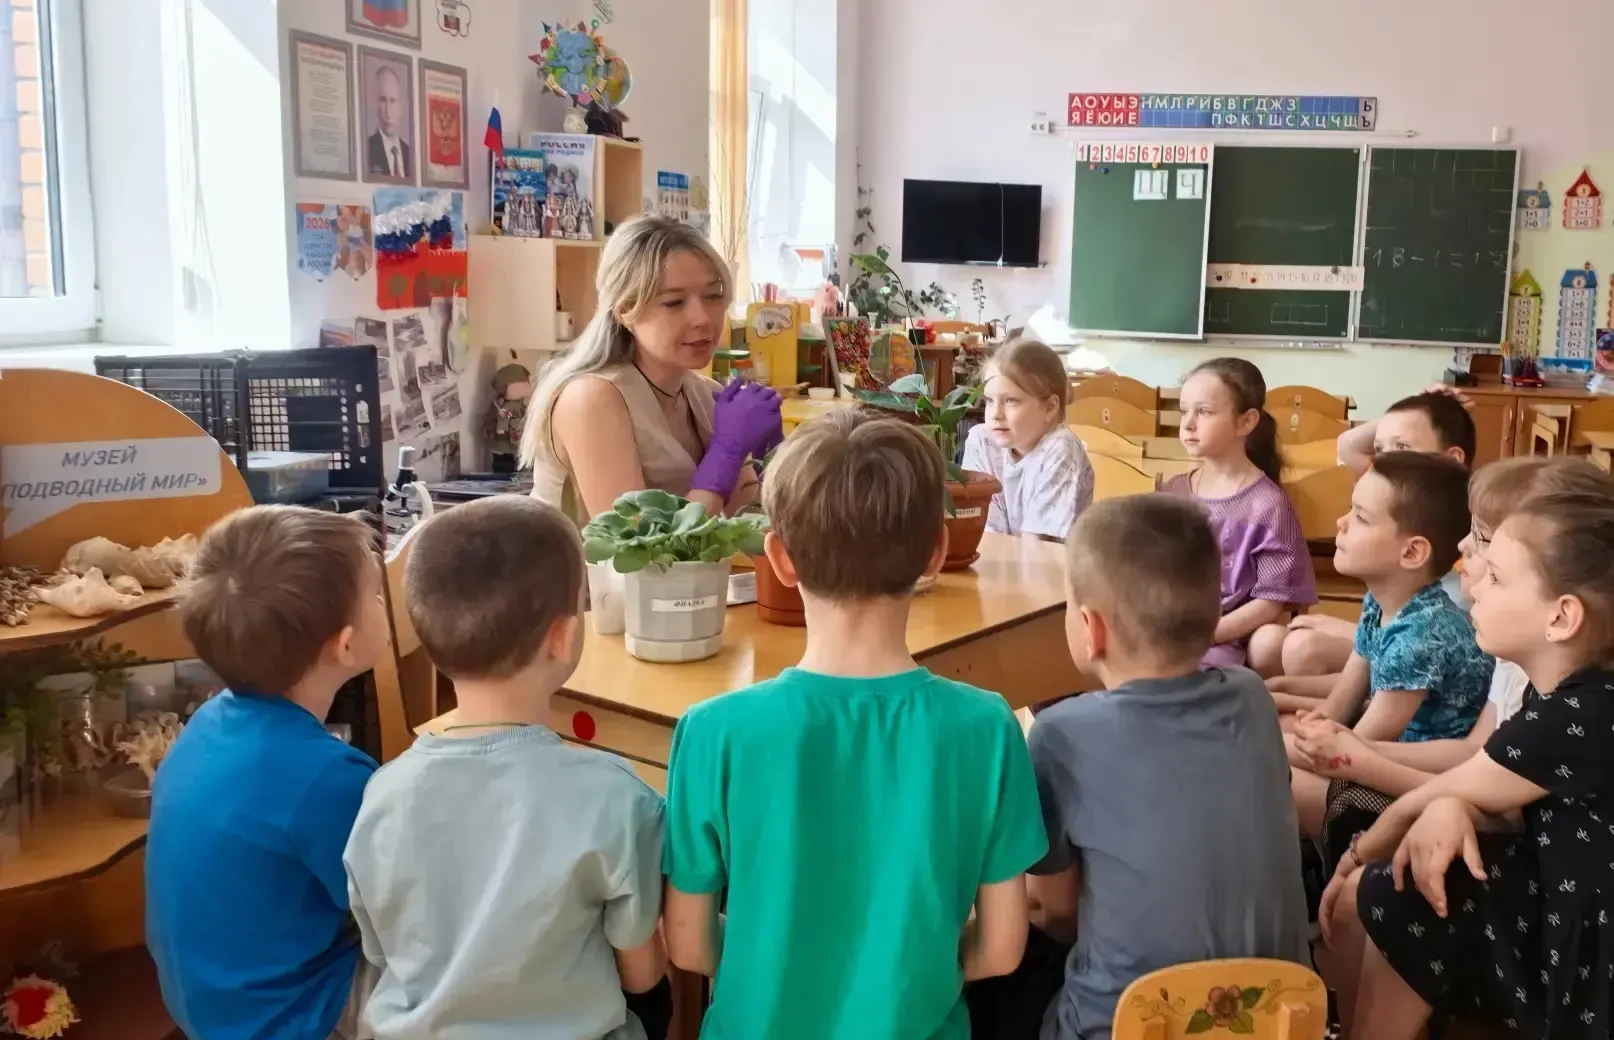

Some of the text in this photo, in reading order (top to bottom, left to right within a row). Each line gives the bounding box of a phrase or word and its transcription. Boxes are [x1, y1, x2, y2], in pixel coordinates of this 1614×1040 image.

[1181, 174, 1197, 196] Ч
[305, 217, 330, 229] 2026
[62, 445, 138, 467] МУЗЕЙ
[2, 472, 208, 500] ПОДВОДНЫЙ МИР»
